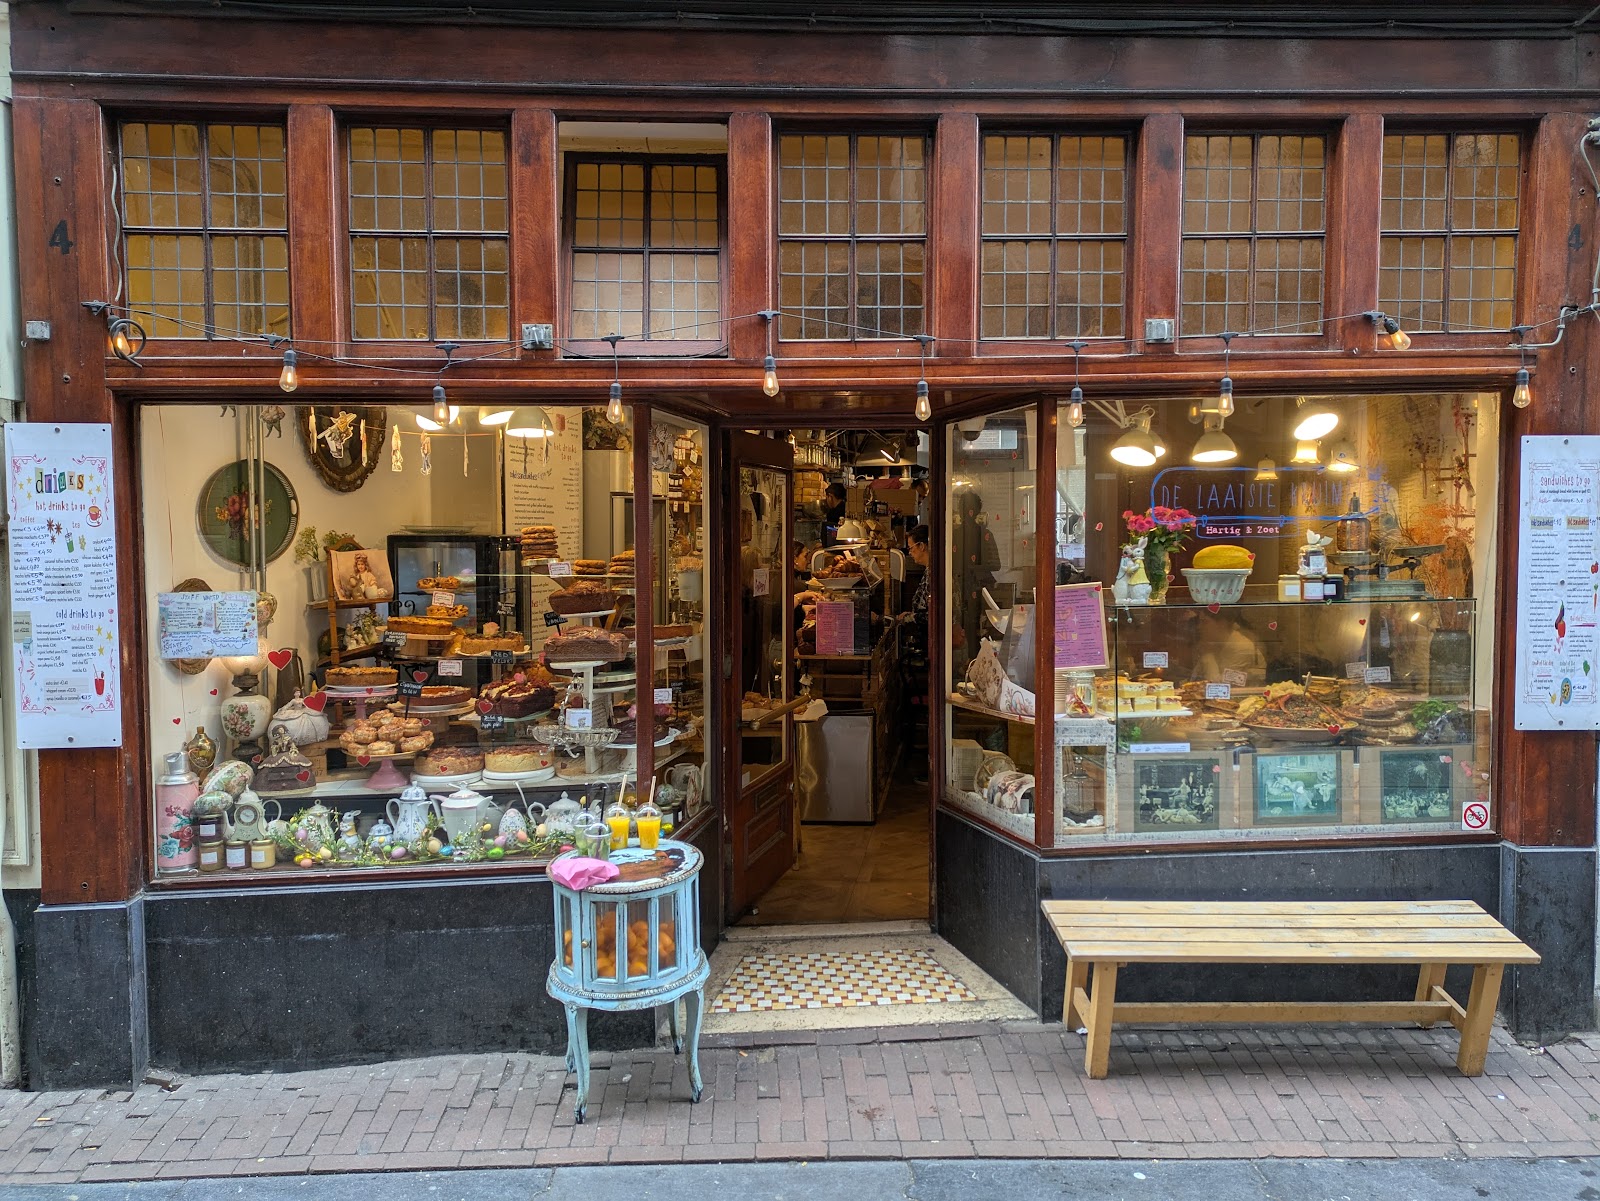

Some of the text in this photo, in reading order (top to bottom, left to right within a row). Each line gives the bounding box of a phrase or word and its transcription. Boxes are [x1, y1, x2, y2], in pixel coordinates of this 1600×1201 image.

[49, 219, 73, 255] 4
[35, 468, 84, 493] drinks
[1161, 484, 1182, 509] DE
[1197, 483, 1276, 509] LAATSTE
[36, 500, 85, 512] hot drinks to go
[72, 521, 80, 529] tea
[1206, 526, 1240, 535] Hartig
[1257, 525, 1279, 534] Zoet
[56, 608, 104, 620] cold drinks to go
